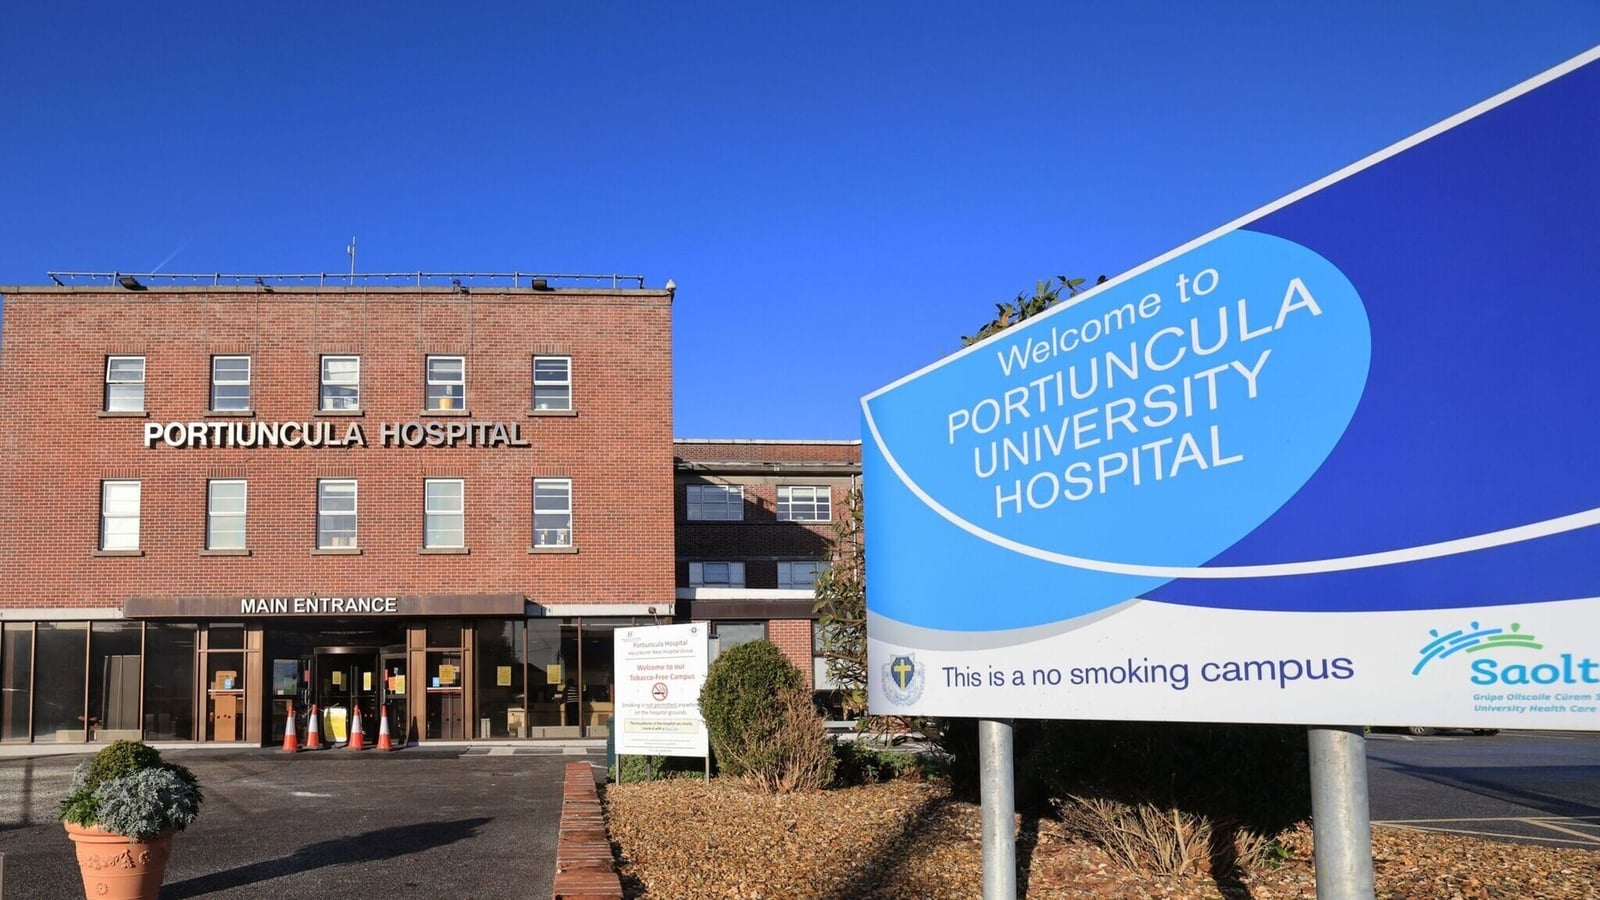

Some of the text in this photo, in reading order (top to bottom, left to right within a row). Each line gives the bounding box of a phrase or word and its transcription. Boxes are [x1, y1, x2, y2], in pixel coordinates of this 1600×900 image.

[997, 268, 1219, 377] Welcome to
[948, 277, 1323, 445] PORTIUNCULA
[974, 349, 1272, 478] UNIVERSITY
[144, 421, 530, 447] PORTIUNCULA HOSPITAL
[995, 425, 1244, 518] HOSPITAL
[241, 597, 398, 614] MAIN ENTRANCE
[632, 639, 688, 649] Portiuncula Hospital
[670, 673, 695, 681] Campus
[943, 657, 1355, 691] This is a no smoking campus
[1470, 653, 1600, 685] Saolt
[1473, 693, 1504, 702] Grúpa
[1554, 693, 1592, 701] Cúram
[1474, 705, 1526, 713] University
